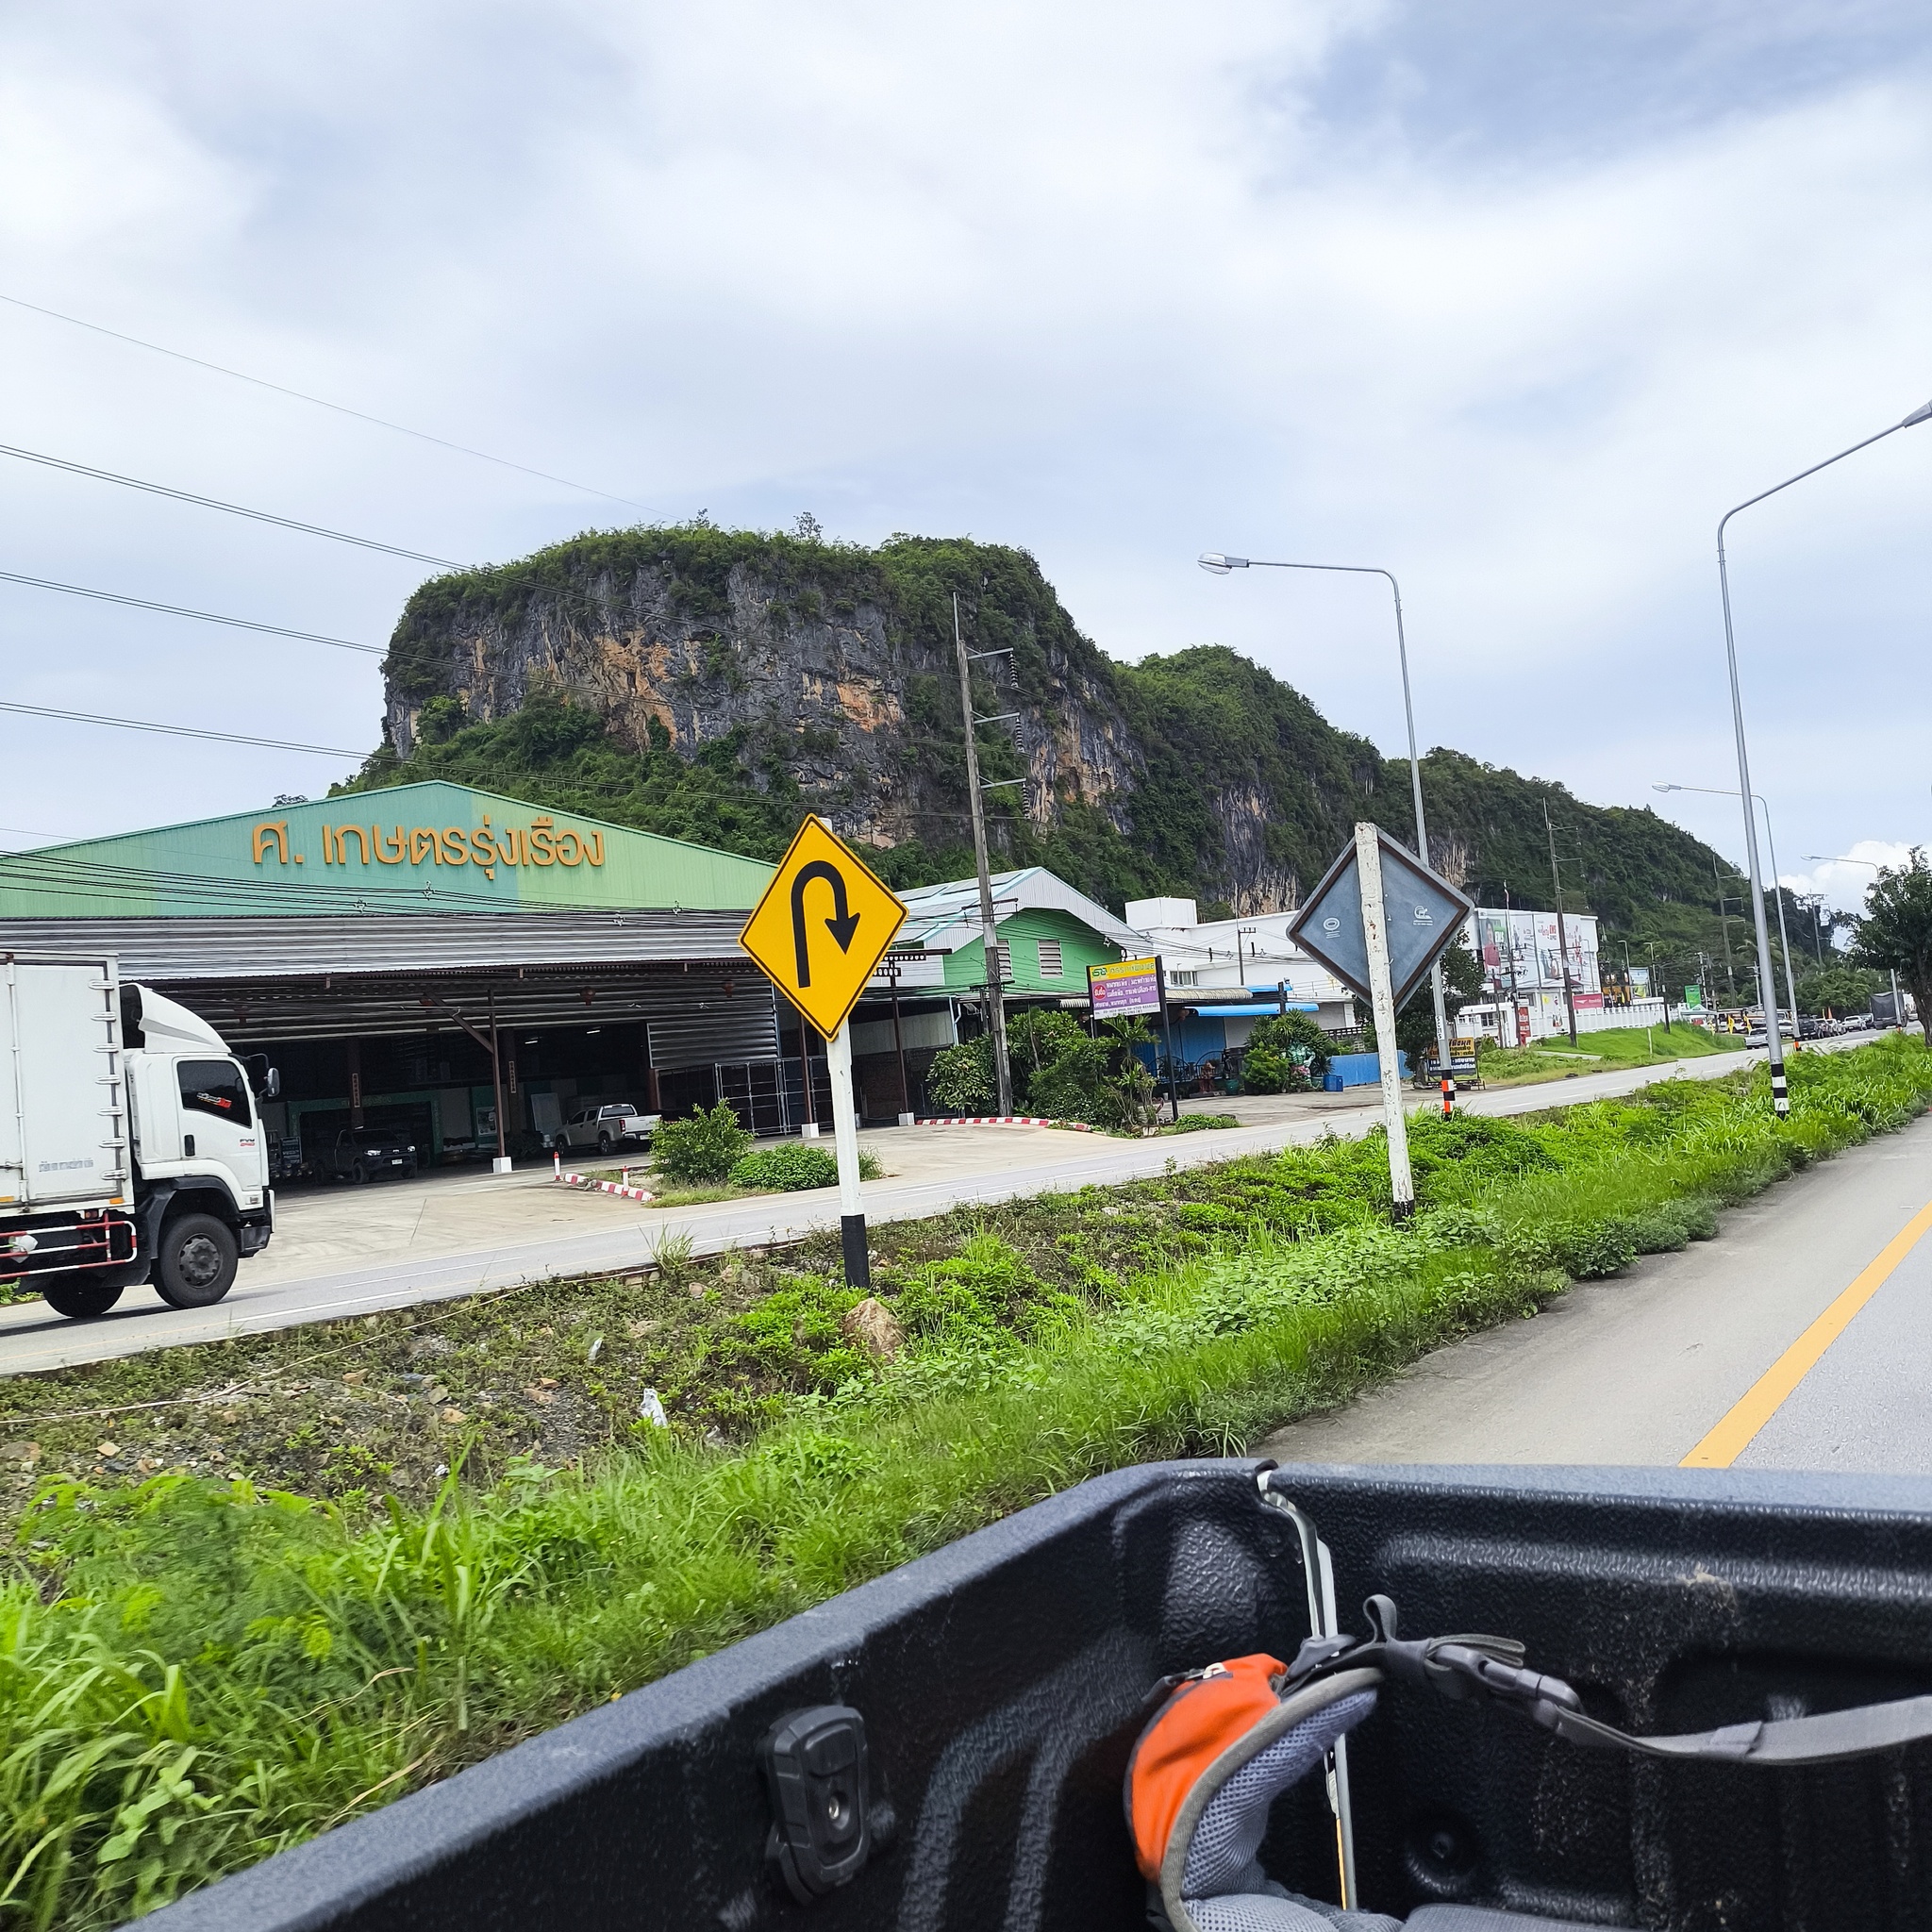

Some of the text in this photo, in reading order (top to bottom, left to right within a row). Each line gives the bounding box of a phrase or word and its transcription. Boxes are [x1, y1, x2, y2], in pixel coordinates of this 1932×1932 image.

[322, 814, 605, 880] เกษตรรุ่งเรือง
